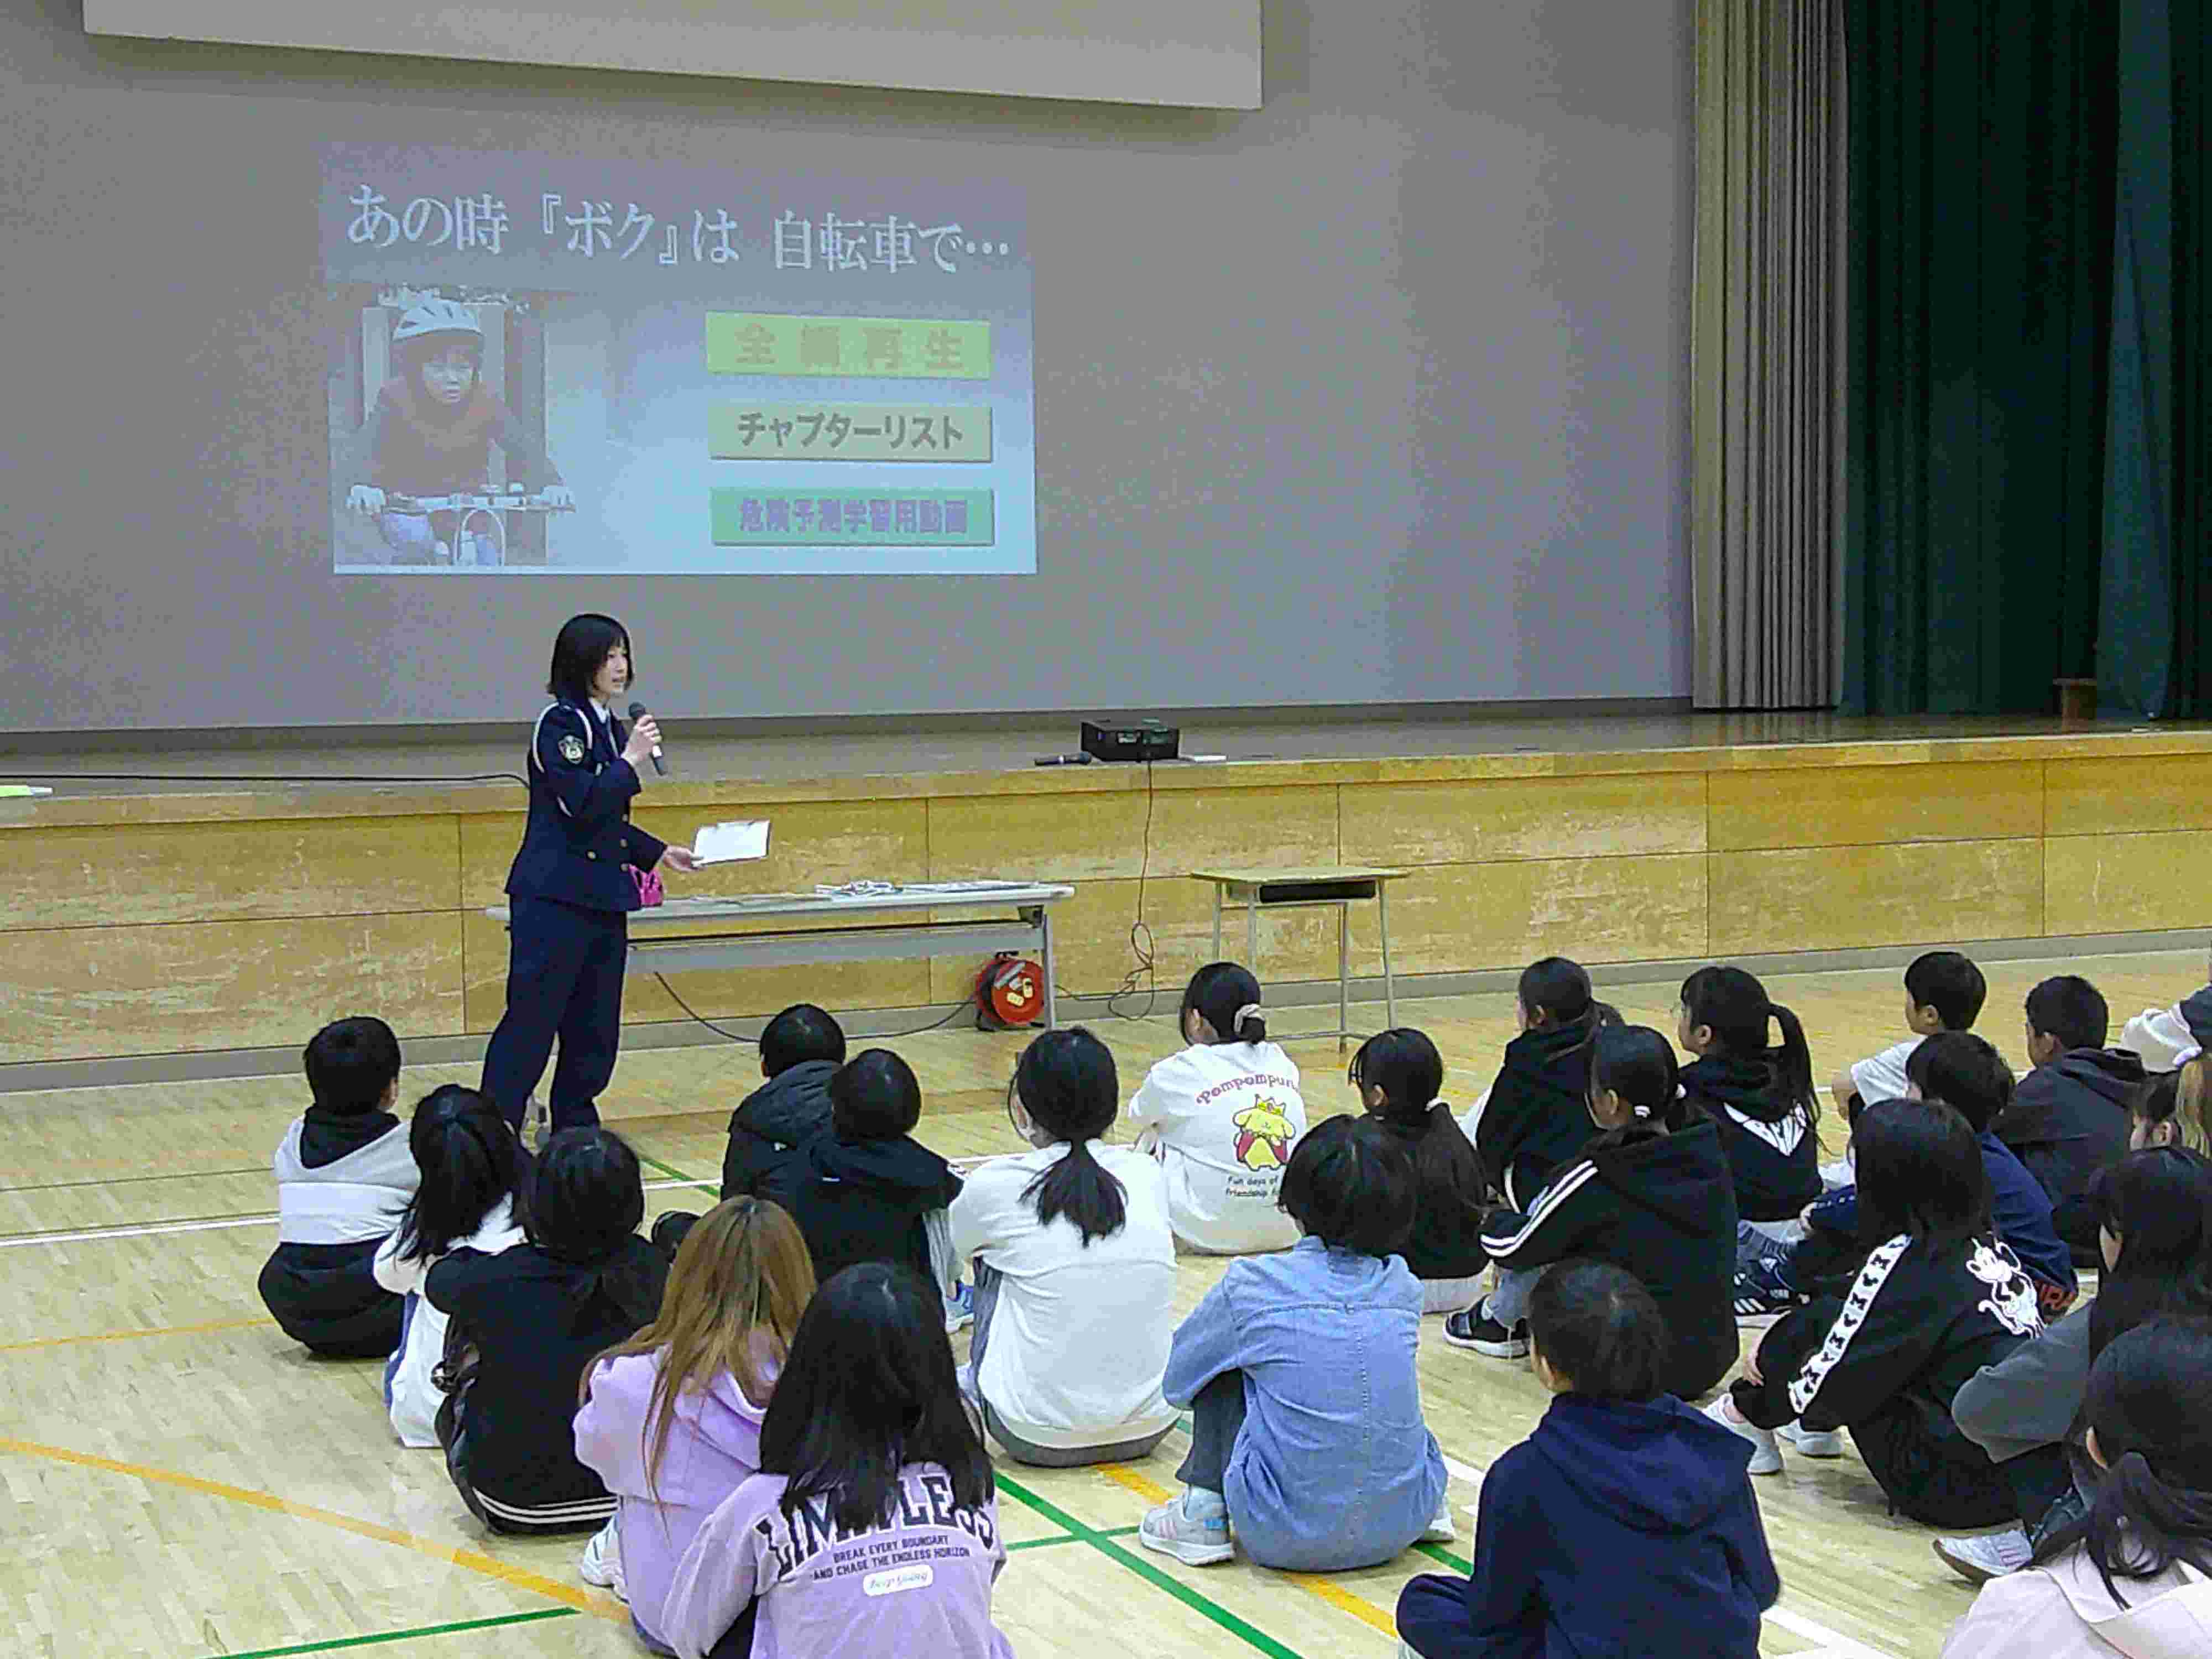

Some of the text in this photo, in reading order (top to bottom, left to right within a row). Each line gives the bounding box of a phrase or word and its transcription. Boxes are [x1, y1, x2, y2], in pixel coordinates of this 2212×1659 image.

[346, 184, 509, 255] あの時
[738, 412, 963, 450] チャプターリスト
[813, 1568, 833, 1580] AND
[836, 1559, 869, 1575] CHASE
[872, 1553, 889, 1566] THE
[833, 1548, 865, 1563] BREAK
[869, 1540, 898, 1555] EVERY
